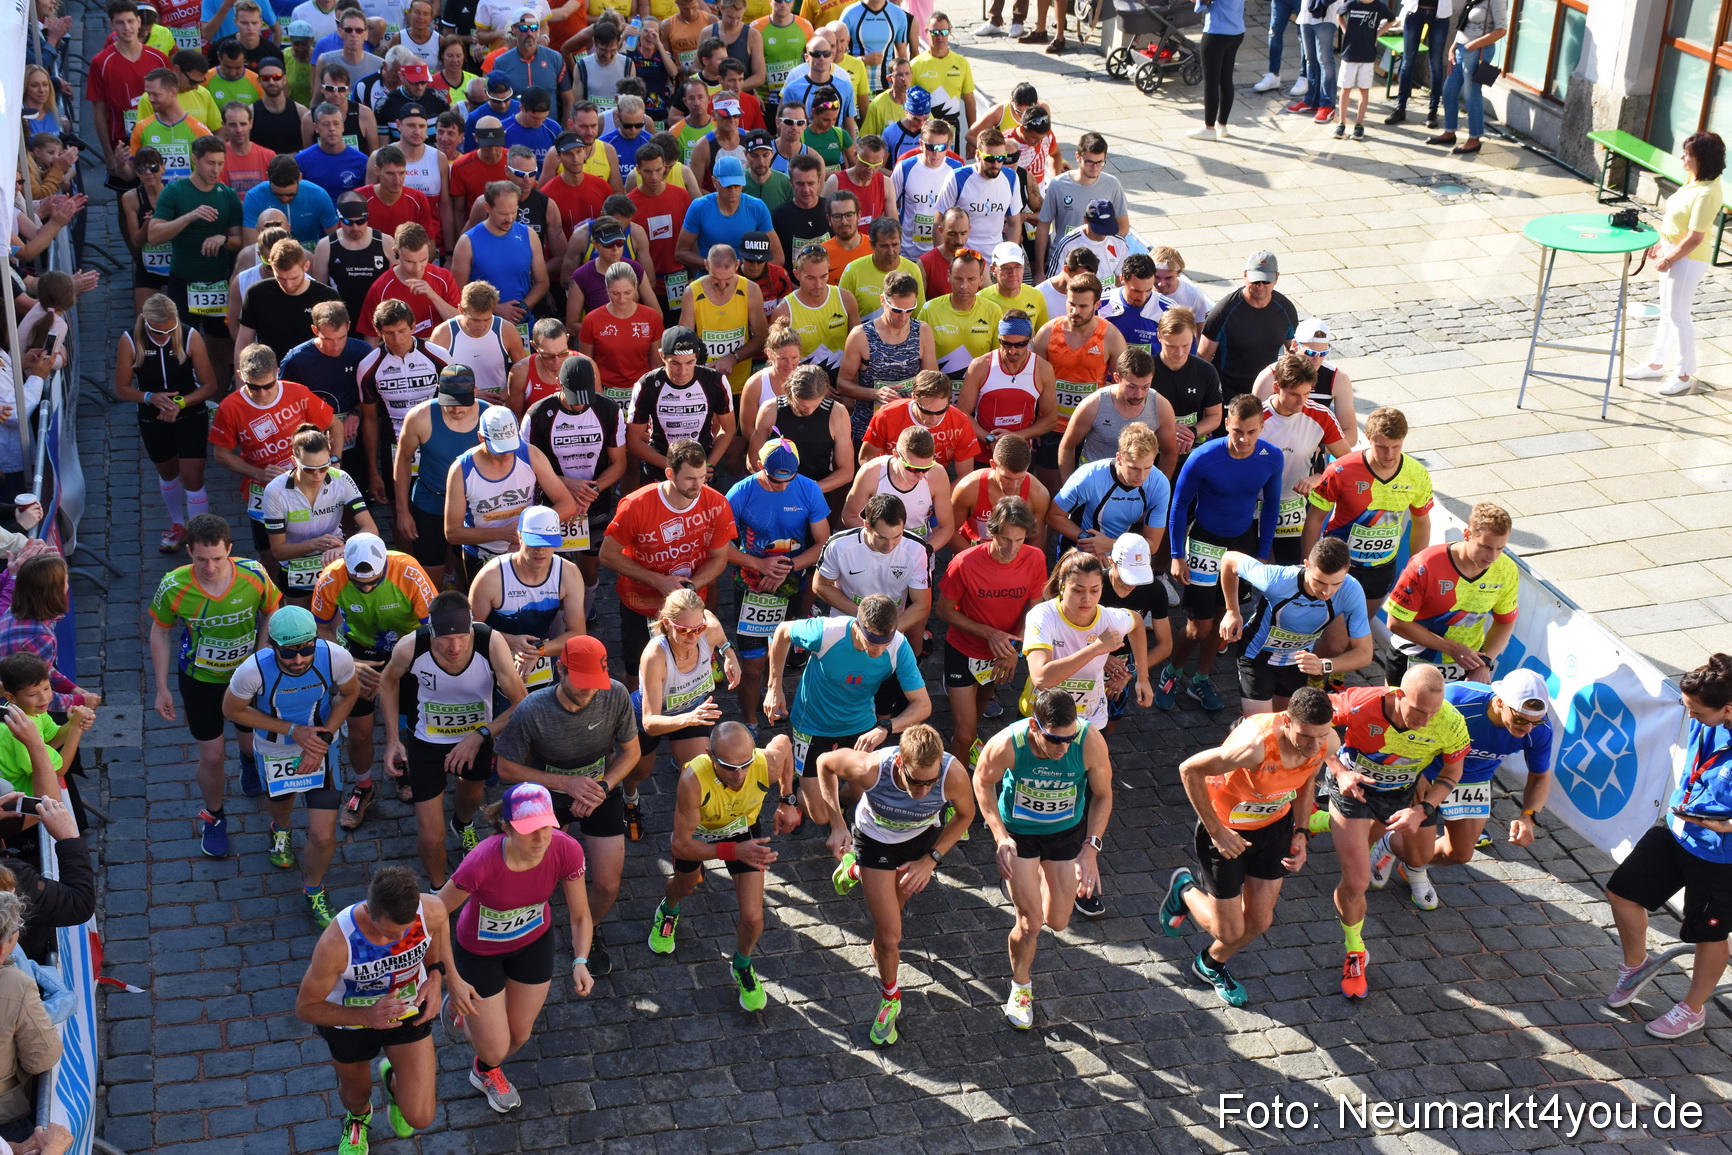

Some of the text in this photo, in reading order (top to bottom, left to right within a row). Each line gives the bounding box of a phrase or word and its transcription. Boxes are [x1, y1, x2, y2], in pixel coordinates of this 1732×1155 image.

[744, 240, 770, 250] OAKLEY
[193, 293, 226, 305] 1323
[707, 329, 743, 341] BOCK
[708, 340, 741, 355] 1012
[1056, 381, 1095, 393] BOCK
[476, 485, 532, 511] ATSV
[1353, 526, 1397, 537] BOCK
[1352, 538, 1393, 551] 2698
[1358, 551, 1385, 559] MAX
[751, 593, 785, 605] BOCK
[745, 607, 783, 623] 2655
[204, 633, 252, 649] BOCK
[206, 645, 249, 660] 1283
[676, 682, 691, 691] TELIS
[428, 703, 480, 713] BOCK
[432, 713, 479, 727] 1233
[436, 725, 476, 734] MARKUS
[1037, 769, 1063, 777] Fischer
[1360, 768, 1410, 782] 2699
[283, 778, 312, 789] ARMIN
[1022, 785, 1072, 800] BOCK
[1021, 796, 1069, 812] 2835
[1442, 806, 1482, 816] ANDREAS
[486, 908, 536, 932] 2742
[353, 941, 428, 977] LA CARRERA
[355, 966, 392, 981] TRITEAM
